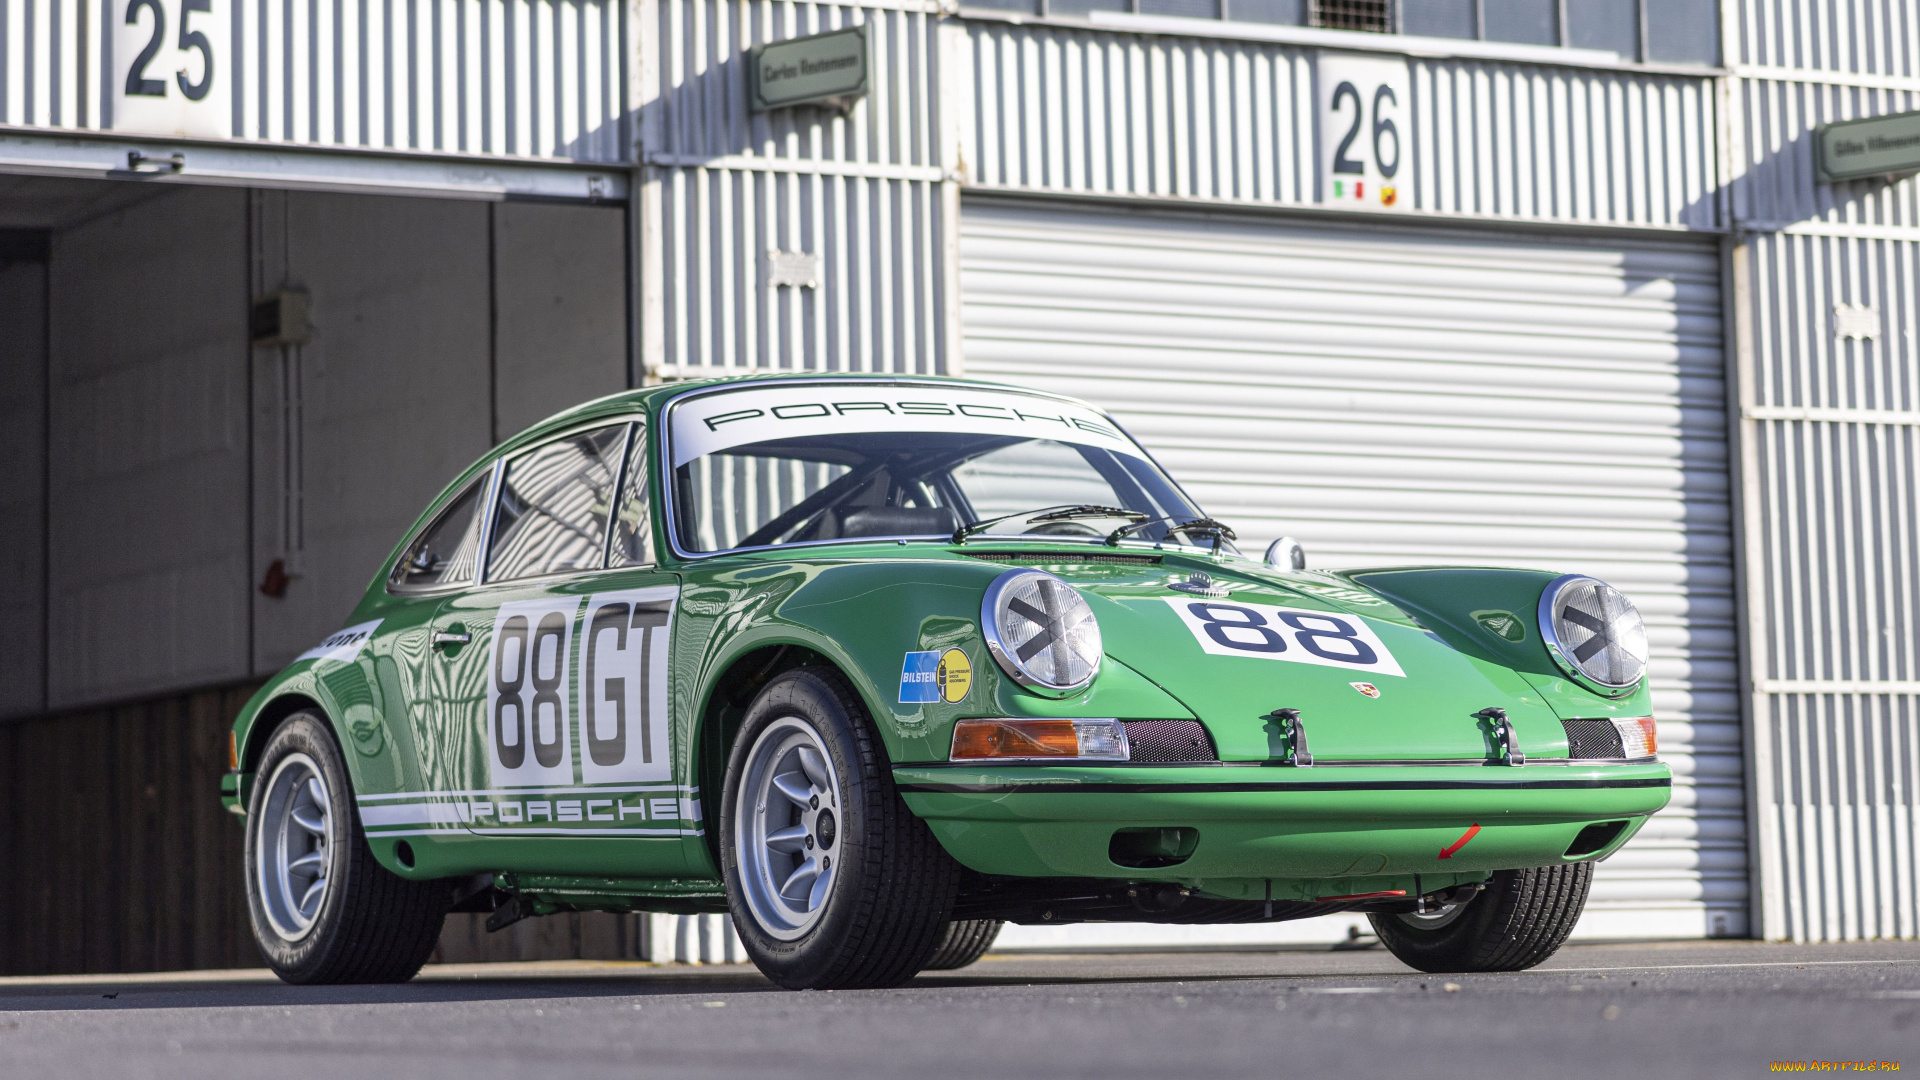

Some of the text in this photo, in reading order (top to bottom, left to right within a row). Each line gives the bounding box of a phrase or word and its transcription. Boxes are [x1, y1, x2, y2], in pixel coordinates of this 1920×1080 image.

[125, 0, 213, 101] 25
[1332, 80, 1400, 179] 26
[702, 401, 1124, 442] PORSCHE
[1187, 602, 1378, 664] 88
[495, 599, 673, 769] 88 GT
[903, 672, 936, 683] BILSTEIN
[471, 798, 678, 822] PORSCHE
